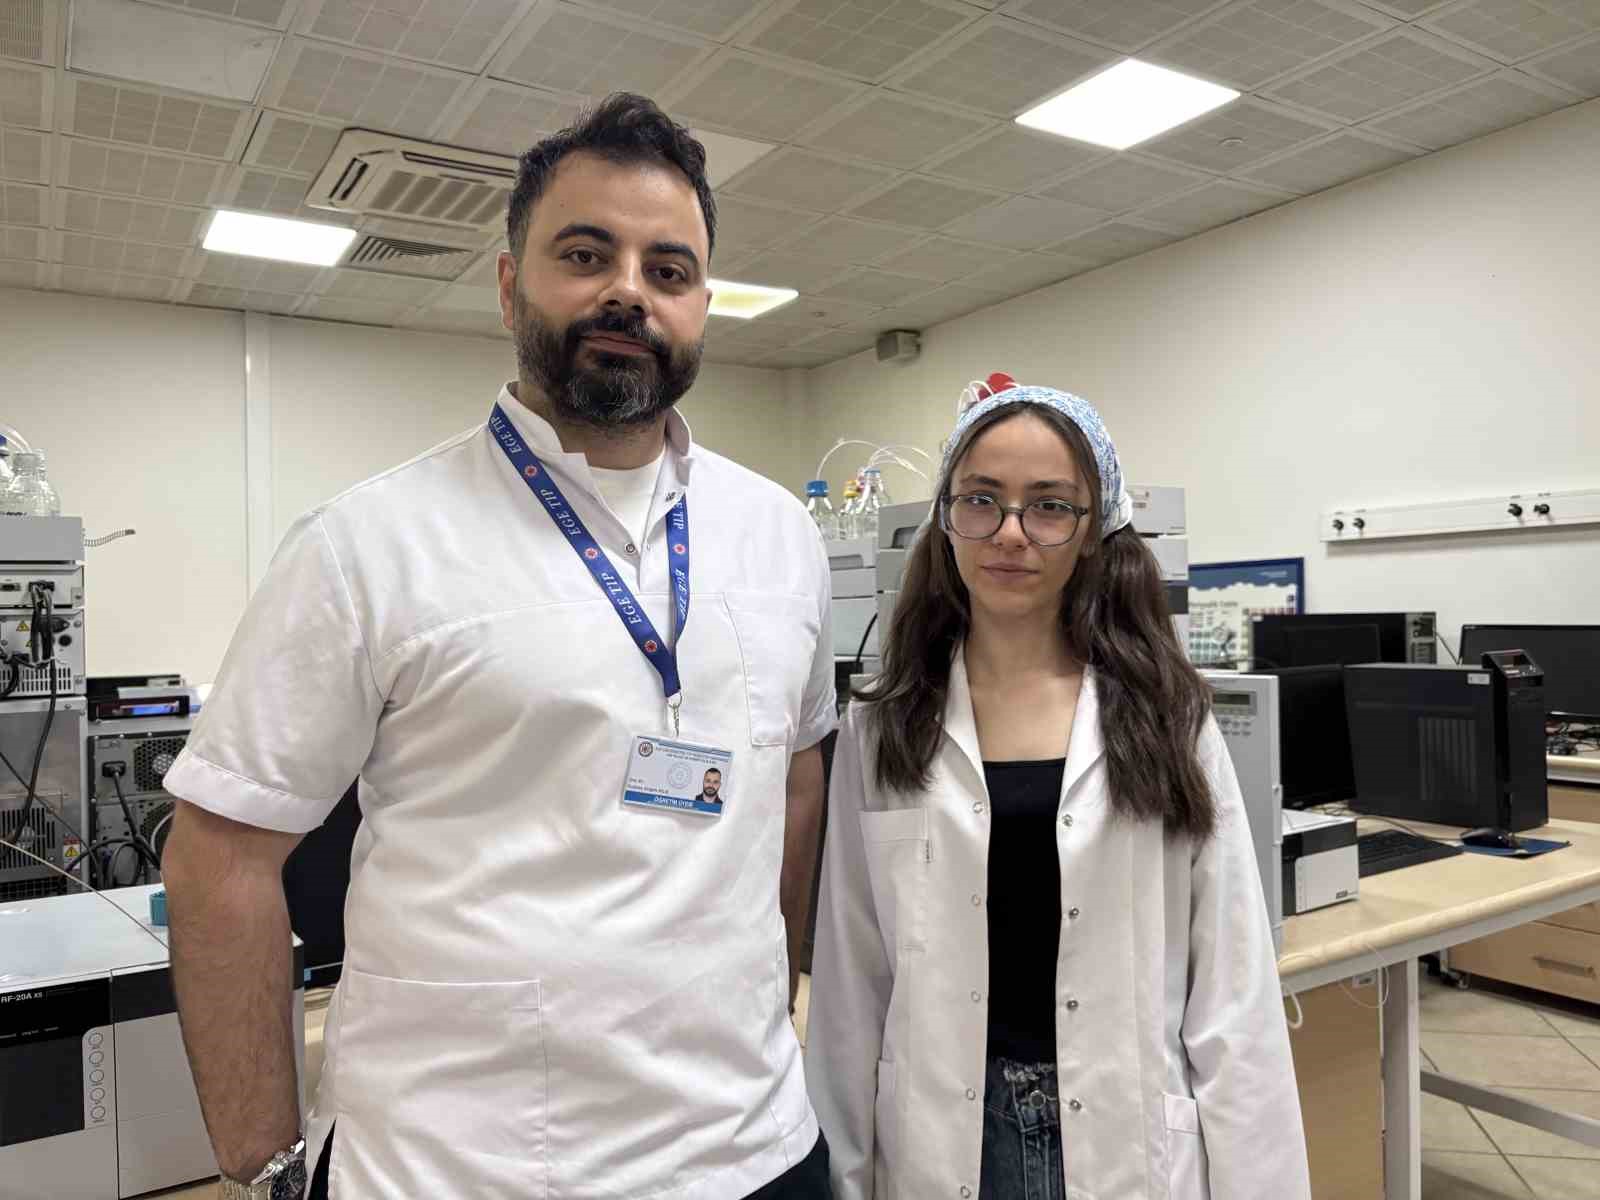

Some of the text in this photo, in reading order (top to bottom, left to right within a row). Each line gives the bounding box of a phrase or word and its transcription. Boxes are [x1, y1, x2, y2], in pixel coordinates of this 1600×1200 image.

[500, 431, 522, 454] EGE
[540, 488, 581, 536] EGE TIP
[672, 512, 684, 530] TIP
[674, 568, 687, 594] EGE
[601, 572, 642, 625] EGE TIP
[1, 992, 32, 1003] RF-20A
